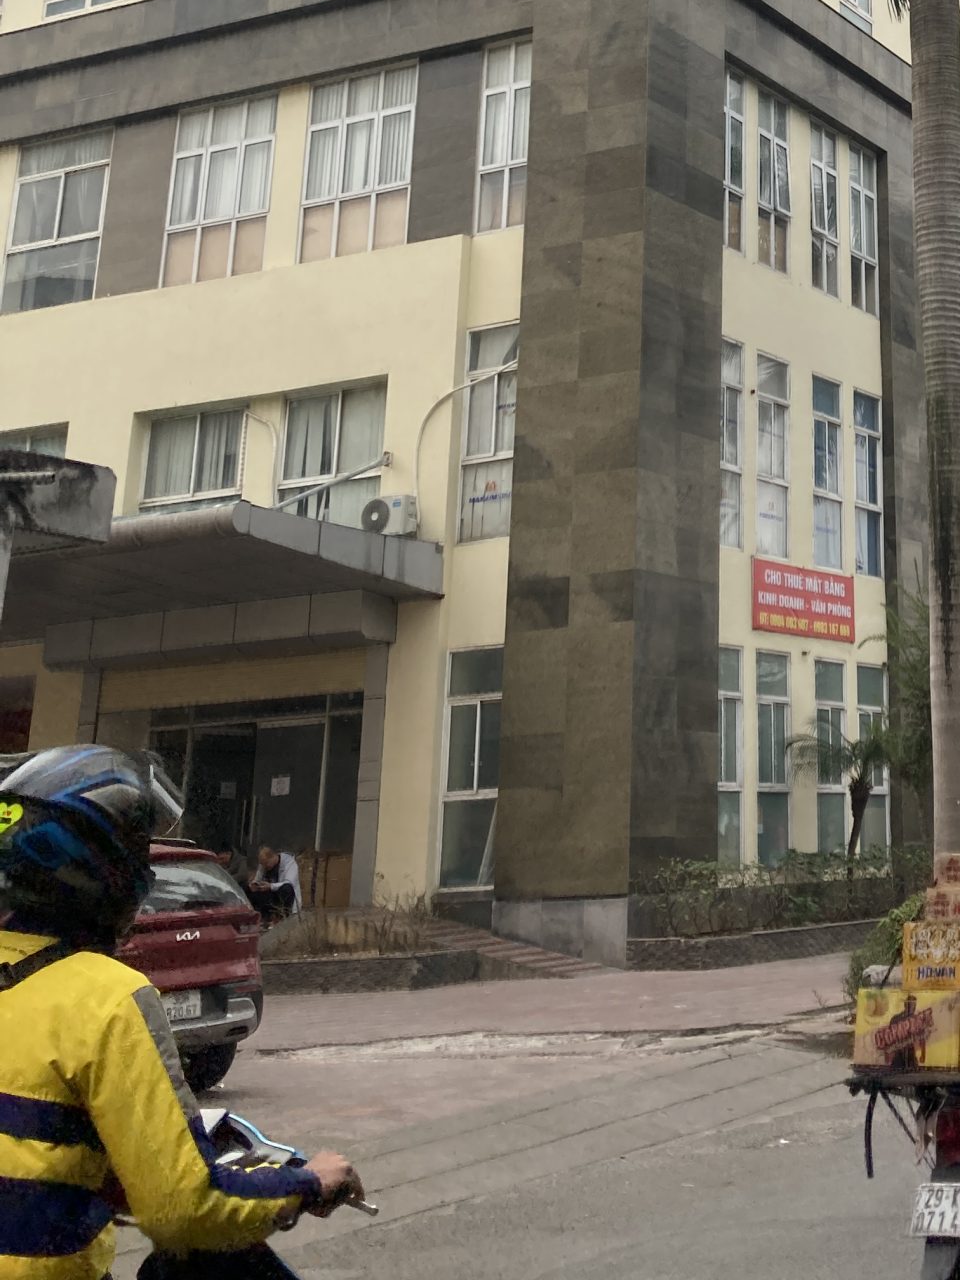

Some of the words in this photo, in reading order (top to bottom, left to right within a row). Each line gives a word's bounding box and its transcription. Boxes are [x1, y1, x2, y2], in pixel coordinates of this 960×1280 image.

[764, 569, 782, 586] CHO
[758, 590, 777, 607] KINH
[778, 594, 805, 611] DOANH
[175, 930, 201, 942] KIA
